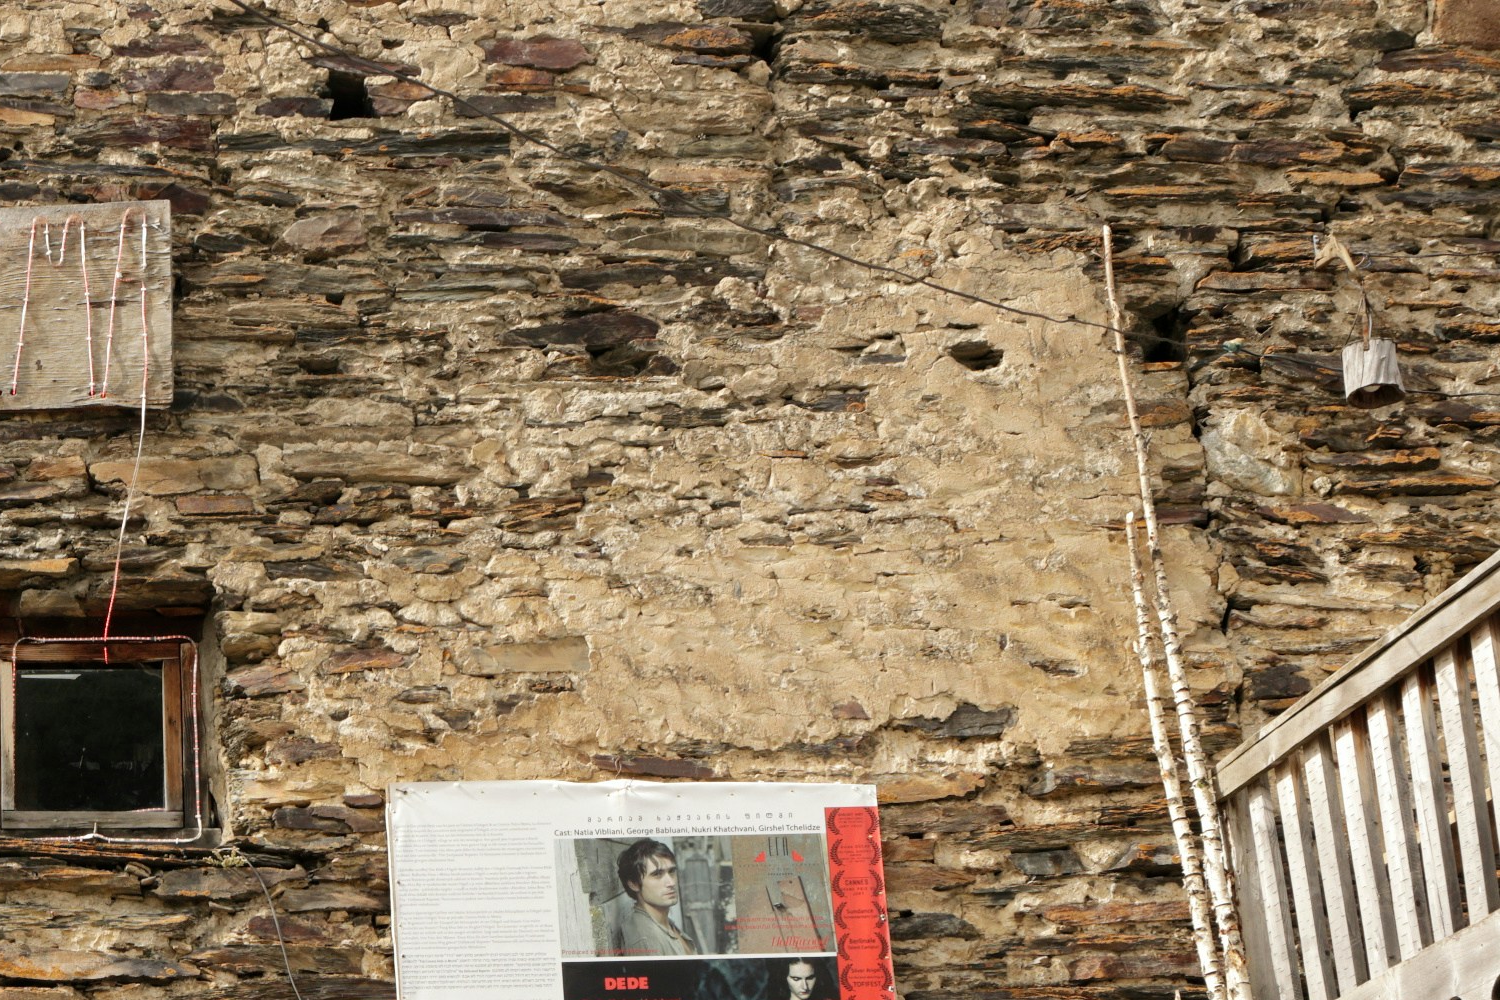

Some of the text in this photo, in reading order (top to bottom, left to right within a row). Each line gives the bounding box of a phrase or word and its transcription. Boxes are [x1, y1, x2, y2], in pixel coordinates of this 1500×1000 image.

[573, 828, 594, 836] Natia
[594, 827, 625, 836] Vibliani,
[626, 827, 654, 836] George
[655, 827, 690, 835] Babluani,
[713, 825, 757, 833] Khatchvani,
[758, 824, 784, 832] Girshel
[604, 976, 649, 991] DEDE
